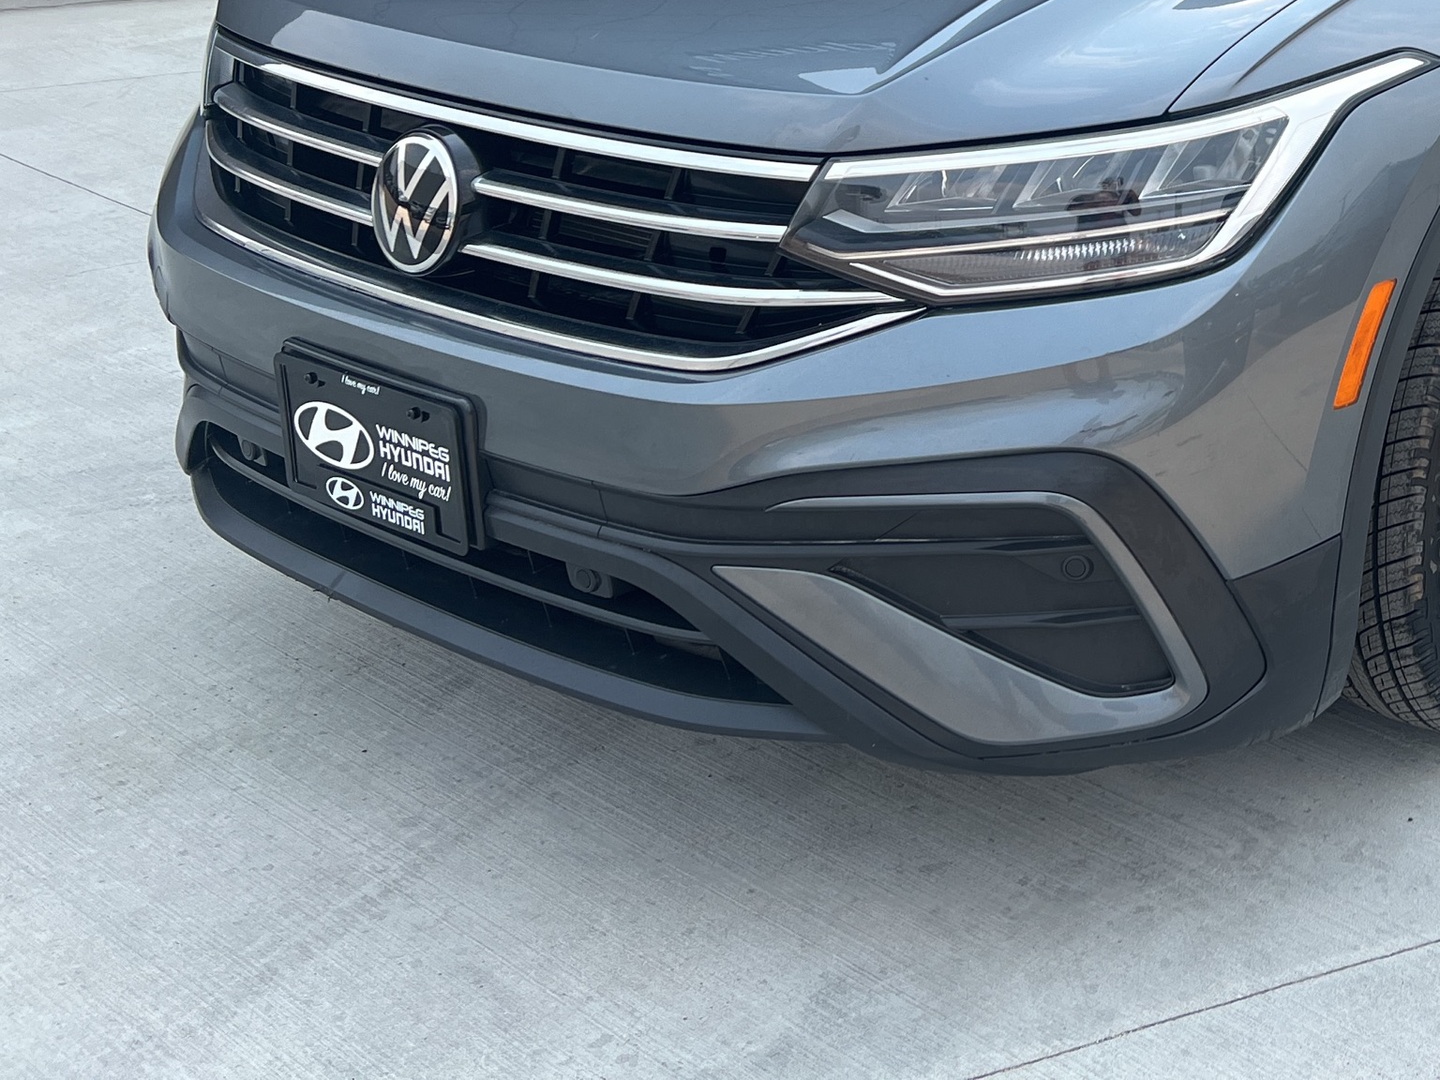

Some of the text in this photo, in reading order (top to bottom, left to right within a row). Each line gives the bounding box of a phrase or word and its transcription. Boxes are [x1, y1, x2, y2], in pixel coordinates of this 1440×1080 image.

[375, 424, 450, 463] WINNIPEG
[379, 440, 451, 483] HYUNDAI
[381, 462, 452, 502] I love my car!
[369, 490, 425, 521] WINNIPEG
[371, 502, 425, 535] HYUNDAI
